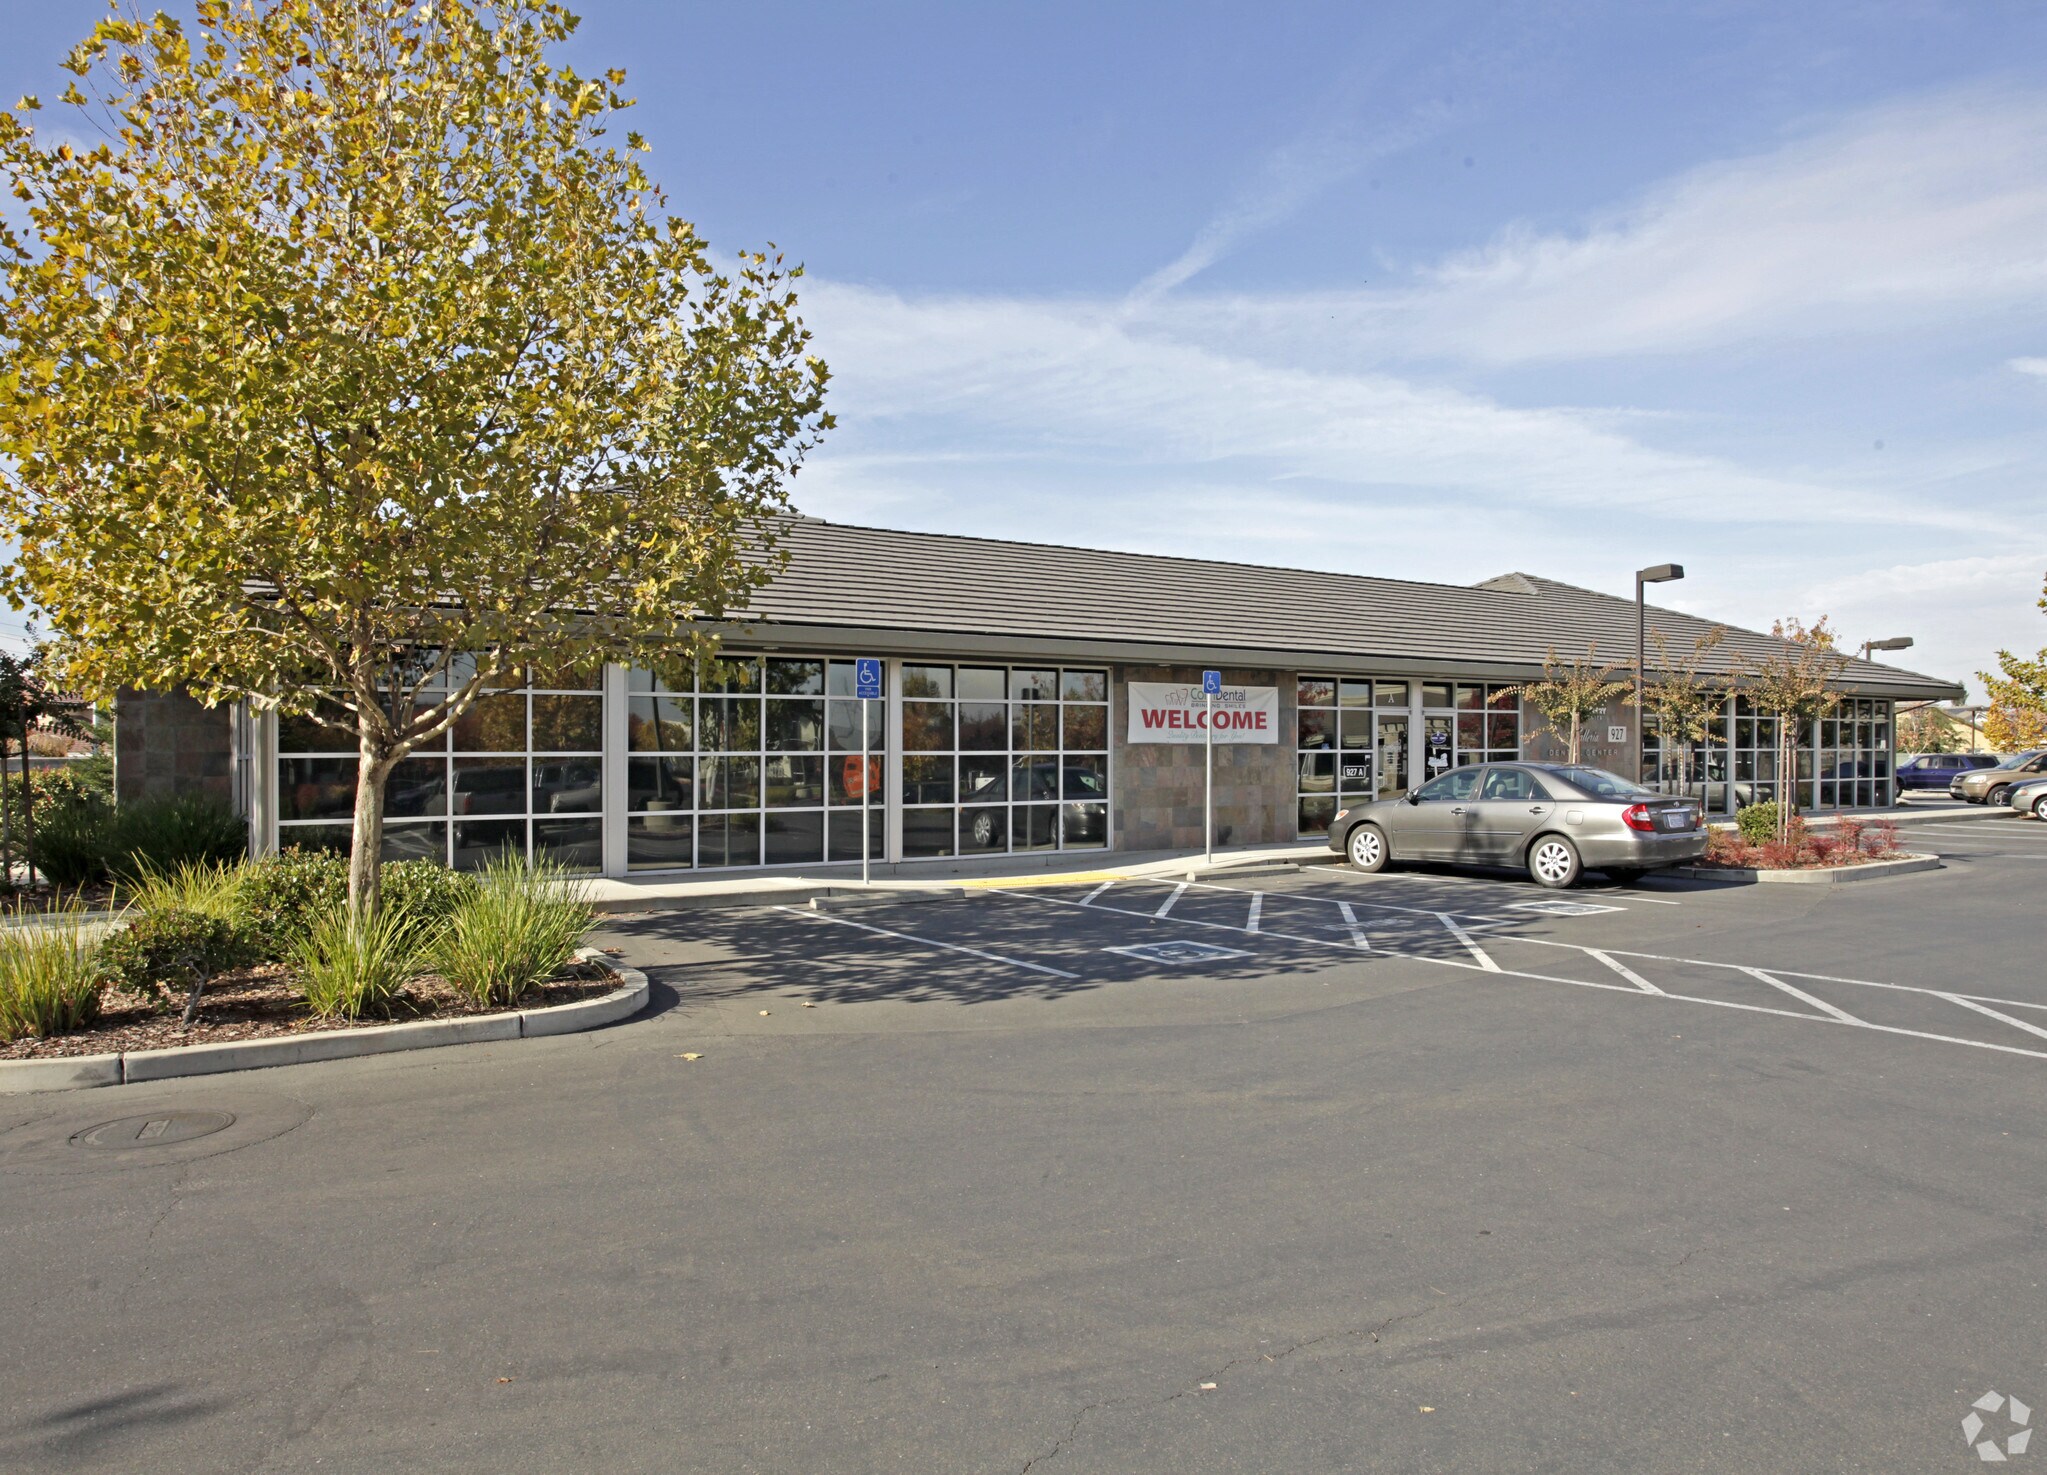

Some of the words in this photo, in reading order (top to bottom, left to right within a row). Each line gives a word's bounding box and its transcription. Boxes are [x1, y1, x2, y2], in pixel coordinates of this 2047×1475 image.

[1387, 692, 1395, 703] A
[1141, 709, 1268, 730] WELCOME
[1610, 728, 1625, 740] 927
[1586, 749, 1619, 757] CENTER
[1346, 768, 1357, 776] 927
[1358, 768, 1363, 776] A
